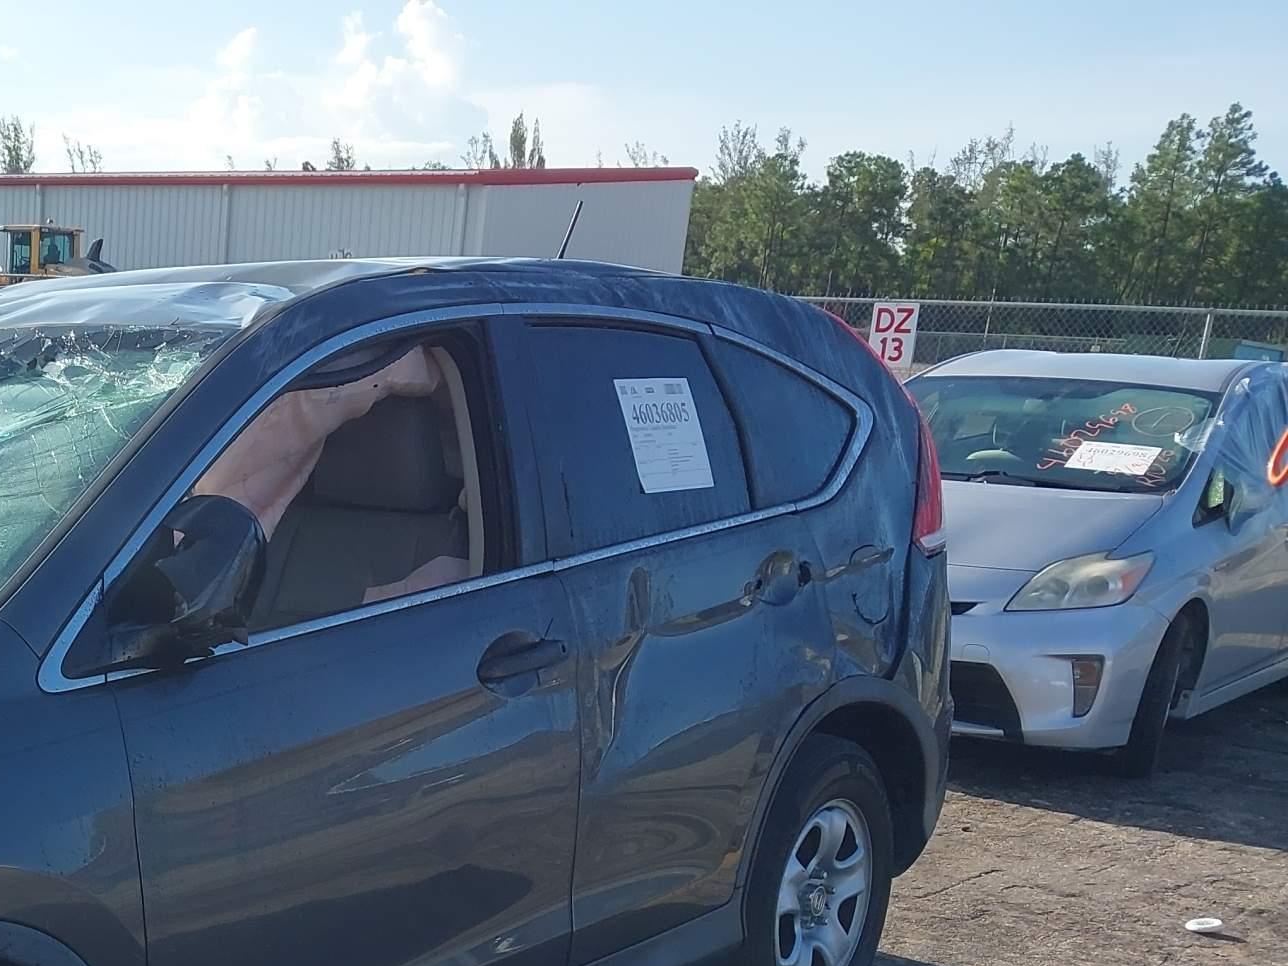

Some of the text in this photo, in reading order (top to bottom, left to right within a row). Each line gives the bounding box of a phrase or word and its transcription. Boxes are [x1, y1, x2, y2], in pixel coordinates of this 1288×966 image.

[875, 308, 914, 333] DZ
[880, 337, 903, 361] 13
[632, 402, 690, 424] 46036805
